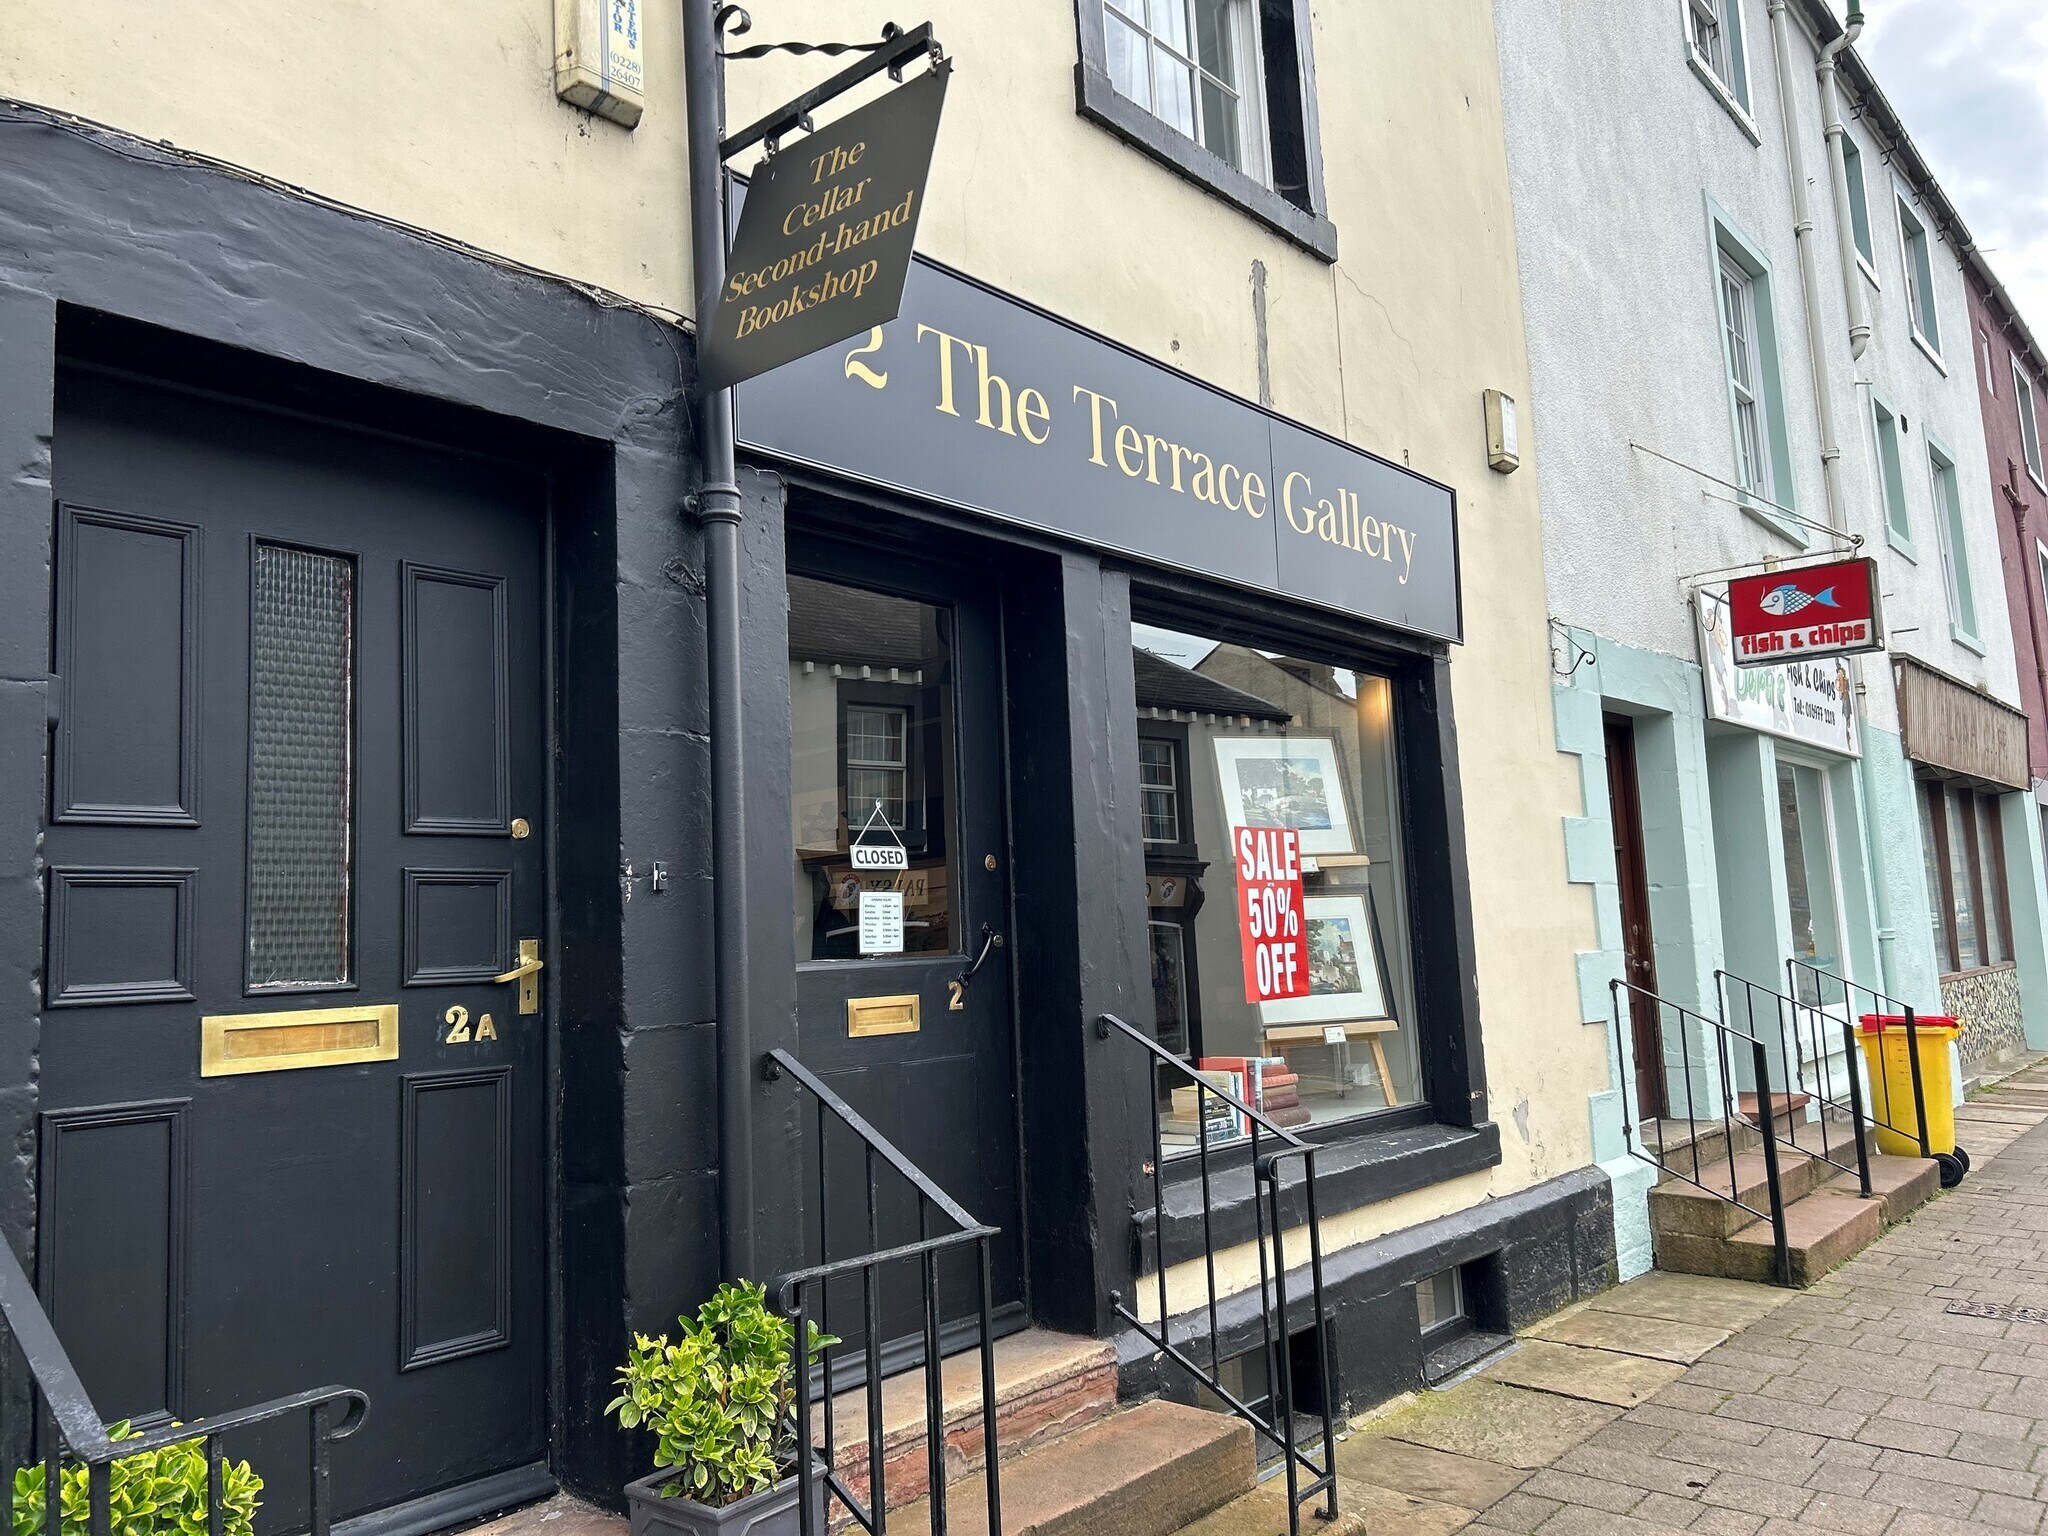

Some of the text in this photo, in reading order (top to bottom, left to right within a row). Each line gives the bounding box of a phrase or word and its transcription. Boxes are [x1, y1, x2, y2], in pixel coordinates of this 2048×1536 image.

[610, 51, 641, 74] (0228)
[610, 66, 640, 87] 26407
[809, 141, 866, 185] The
[782, 177, 873, 236] Cellar
[725, 189, 914, 304] Second-hand
[734, 259, 878, 340] Bookshop
[844, 322, 1417, 585] 2 The Terrace Gallery
[1741, 624, 1865, 654] fish & chips
[1813, 668, 1836, 701] Chips
[855, 850, 904, 865] CLOSED
[1240, 829, 1298, 881] SALE
[1247, 887, 1299, 938] 50%
[1256, 942, 1297, 996] OFF
[948, 981, 964, 1010] 2
